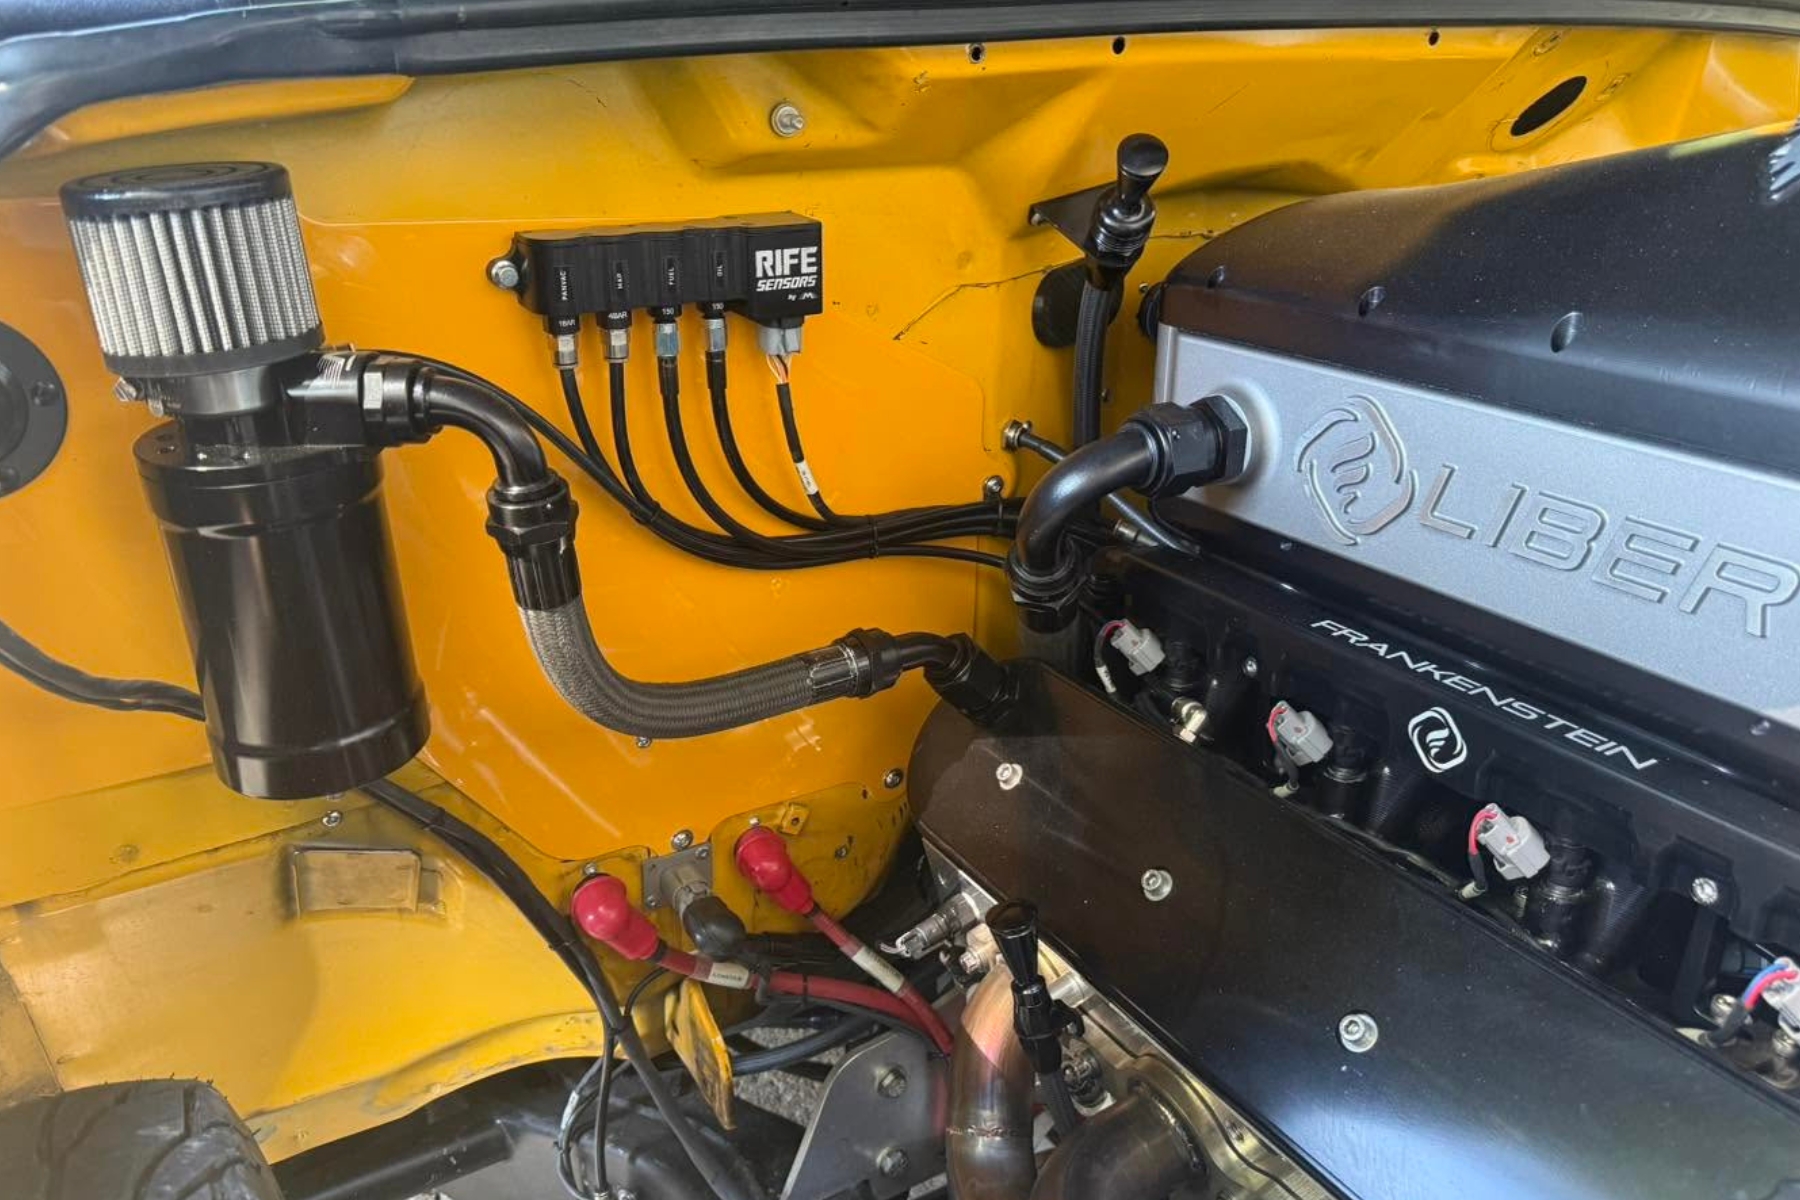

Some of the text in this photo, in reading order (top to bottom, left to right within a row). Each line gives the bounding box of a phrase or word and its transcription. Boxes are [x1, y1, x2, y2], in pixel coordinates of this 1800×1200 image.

[755, 246, 818, 278] RIFE
[560, 270, 568, 301] PANVAC
[756, 275, 818, 292] SENSORS
[1419, 463, 1800, 638] LIBER
[1311, 619, 1658, 771] FRANKENSTEIN
